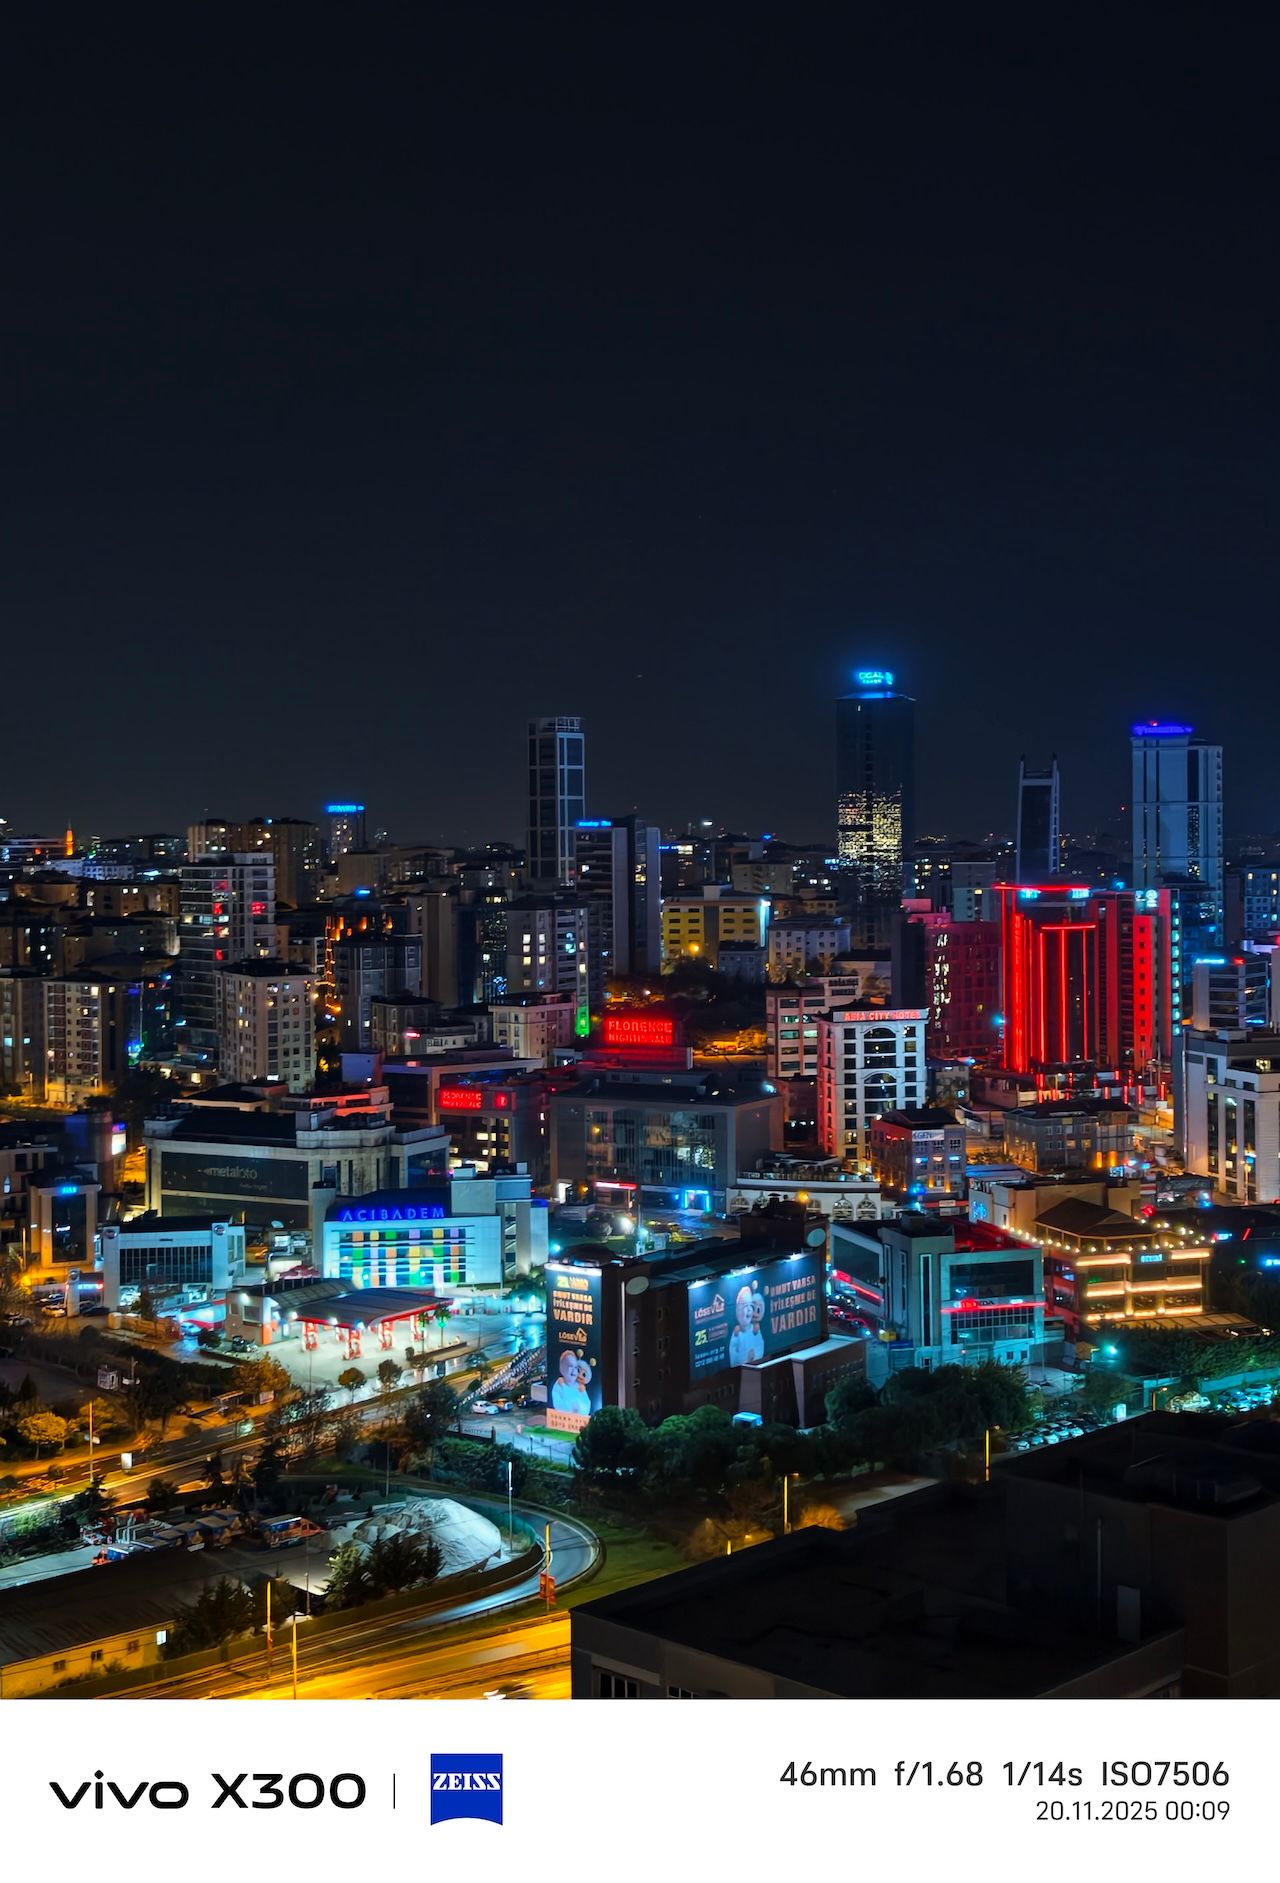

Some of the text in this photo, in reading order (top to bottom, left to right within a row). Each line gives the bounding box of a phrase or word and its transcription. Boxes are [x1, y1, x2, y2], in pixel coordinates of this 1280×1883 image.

[845, 1009, 921, 1021] ASIA CITY HOTEL
[608, 1020, 673, 1033] FLORENCE
[342, 1206, 445, 1222] ACIBADEM
[553, 1309, 593, 1325] VARDIR
[771, 1305, 816, 1335] VARDIR
